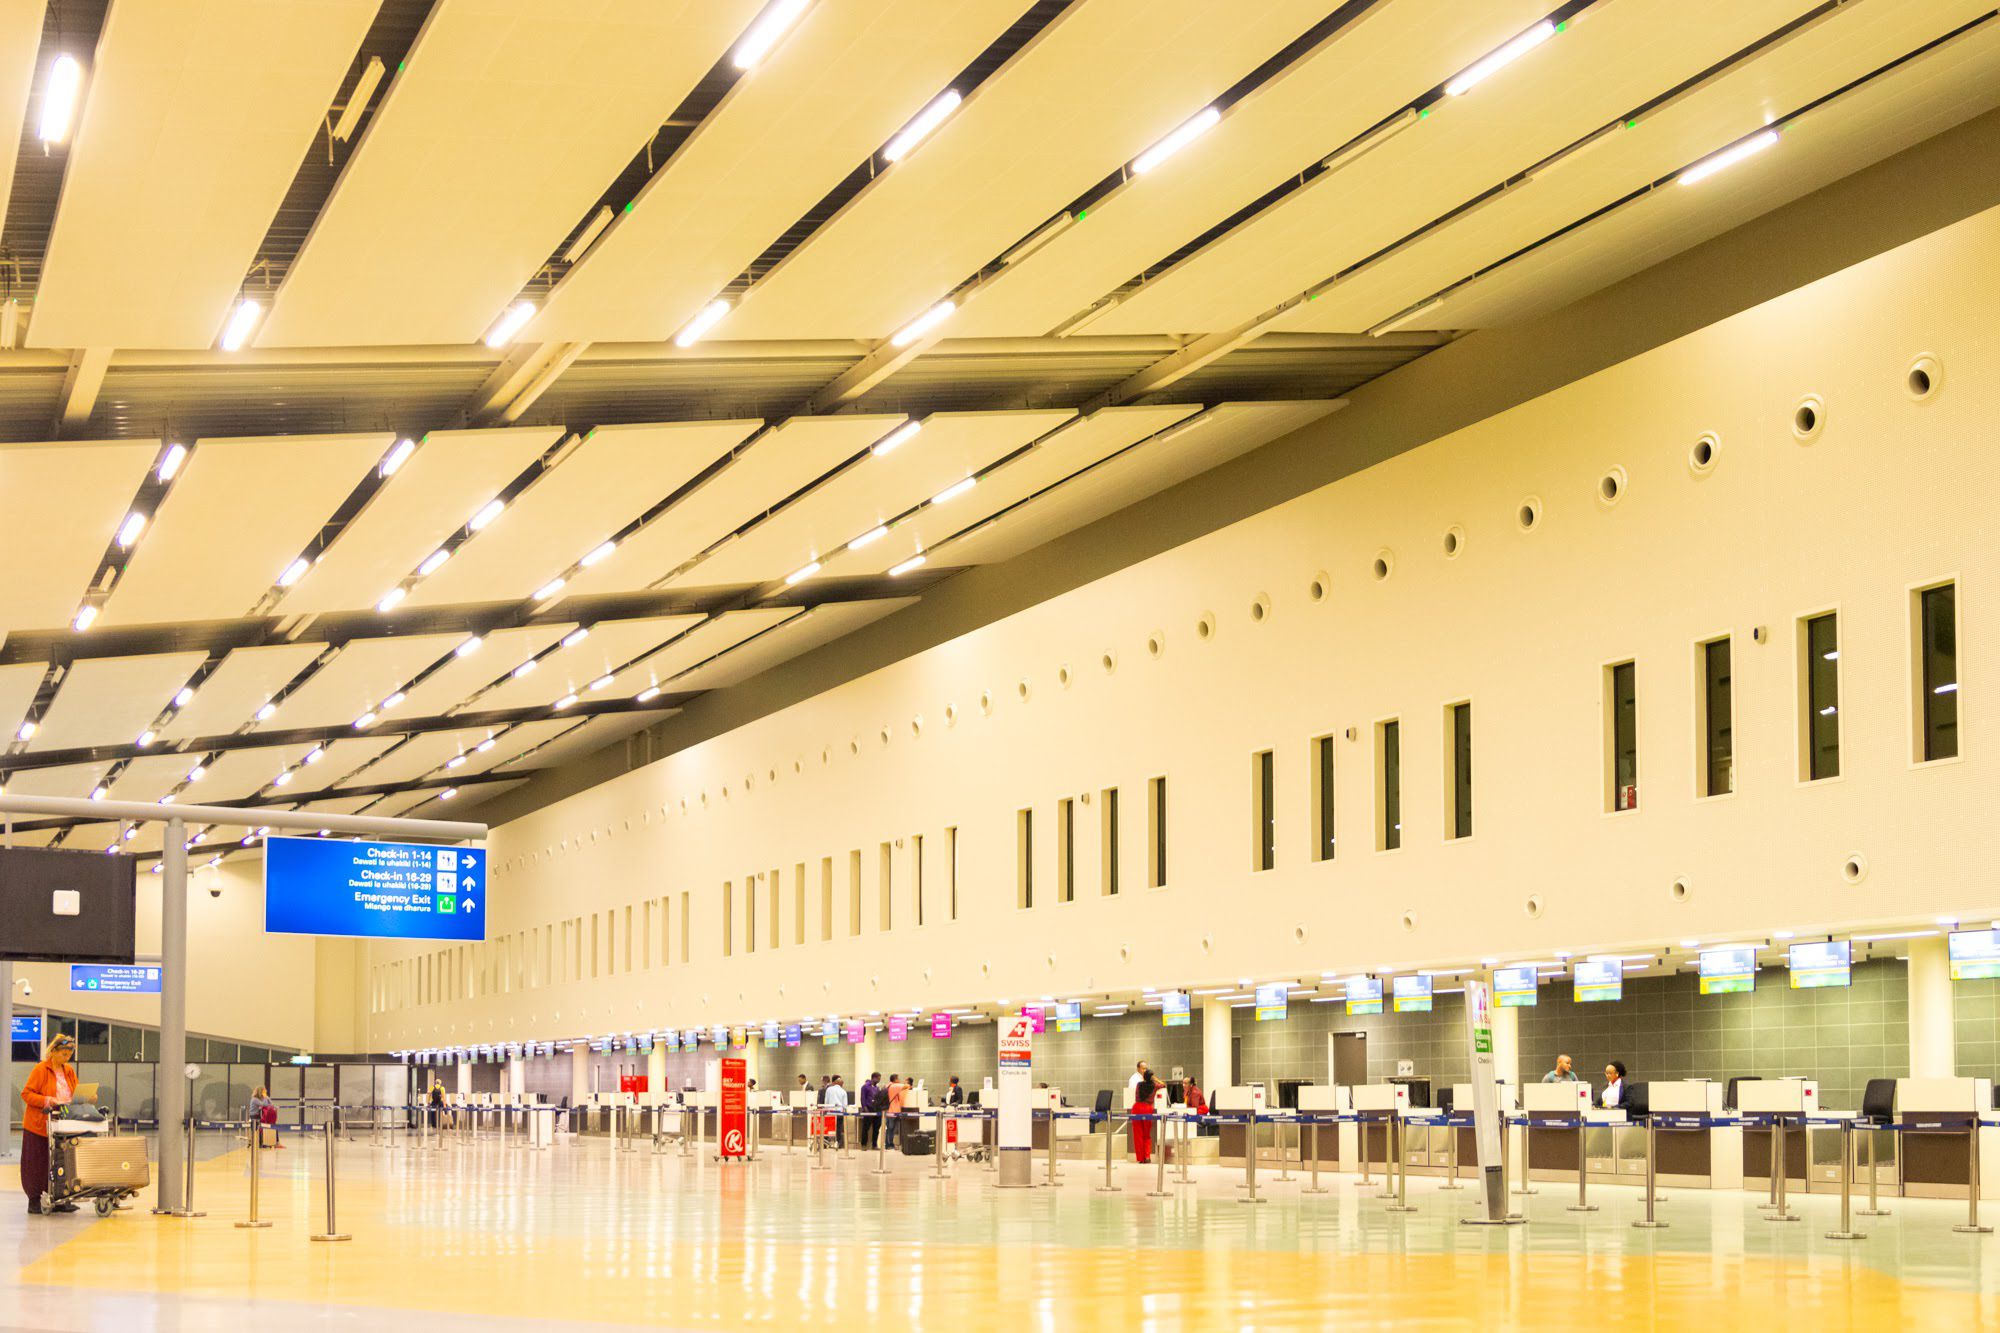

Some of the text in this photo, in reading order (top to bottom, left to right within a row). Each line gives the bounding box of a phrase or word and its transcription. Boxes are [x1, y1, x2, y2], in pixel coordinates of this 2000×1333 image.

[367, 848, 432, 860] Check-in 1-14
[412, 861, 432, 869] (1-14)
[361, 869, 432, 882] Check-in 16-29
[354, 891, 431, 905] Emergency Exit
[1001, 1039, 1030, 1048] SWISS
